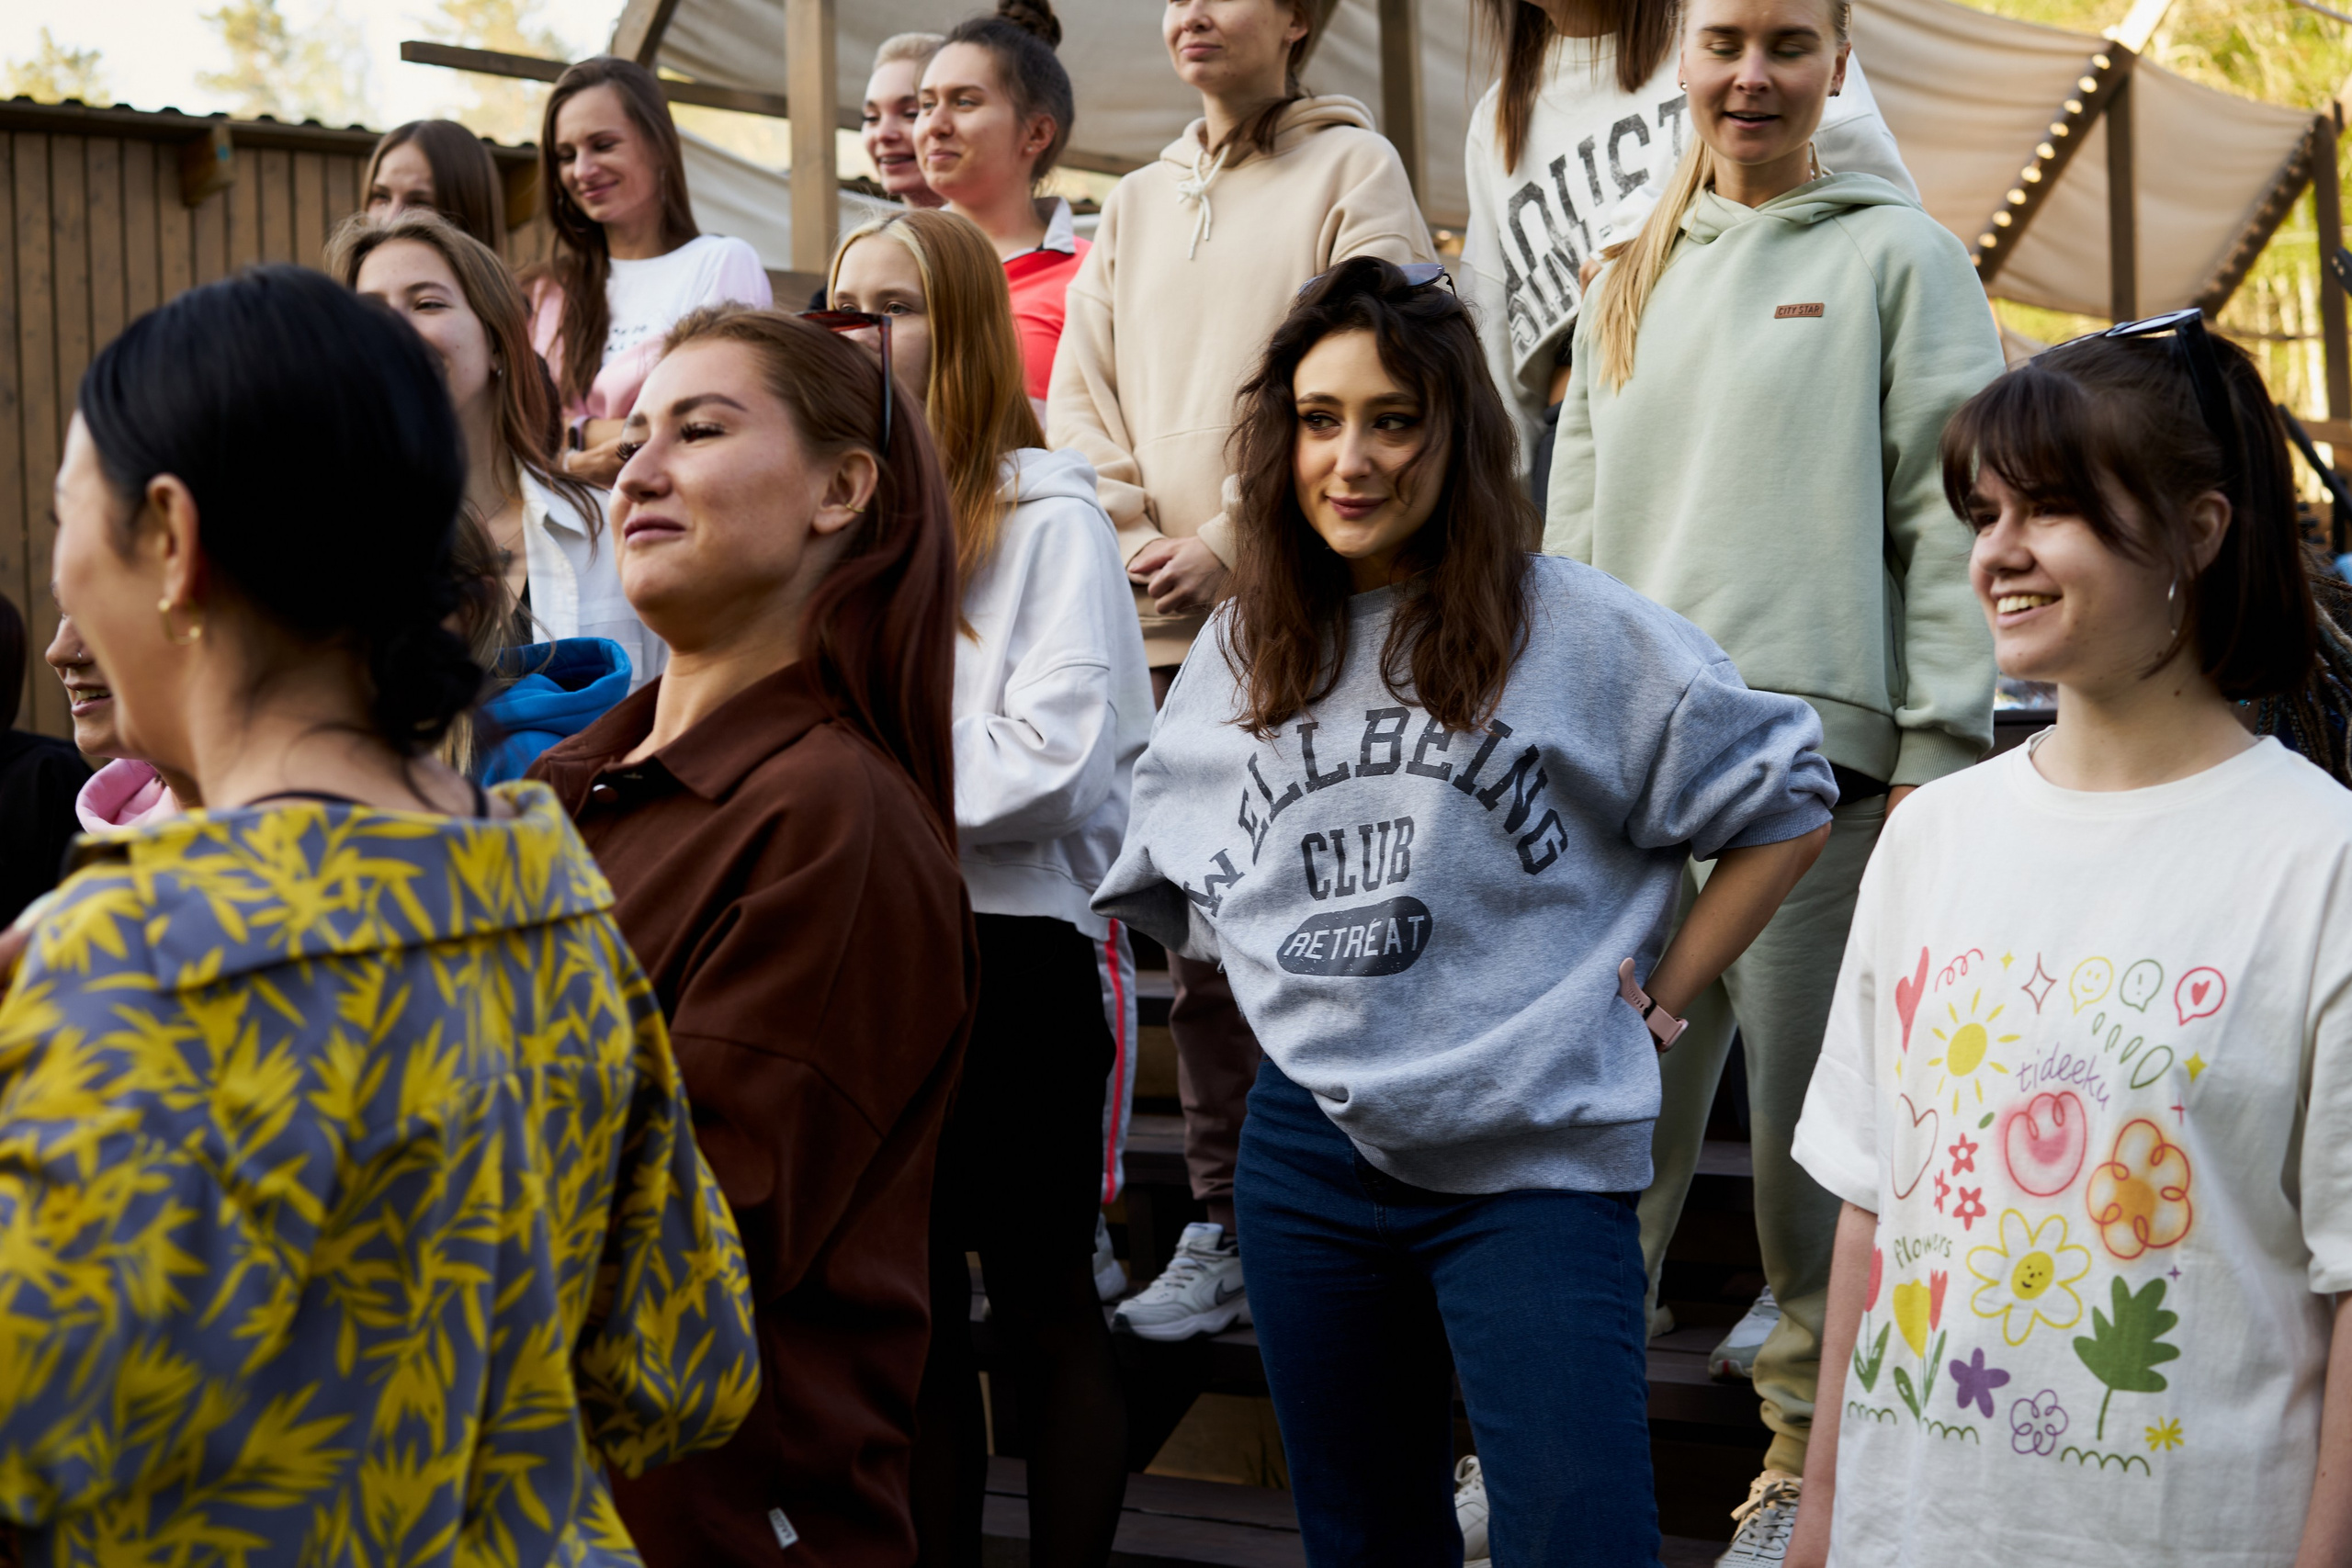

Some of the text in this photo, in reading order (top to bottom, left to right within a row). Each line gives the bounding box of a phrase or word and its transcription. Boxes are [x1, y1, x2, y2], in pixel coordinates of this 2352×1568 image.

[1778, 304, 1821, 316] CITY STAR
[1183, 706, 1568, 917] WELLBEING
[1301, 816, 1415, 901] CLUB
[1283, 915, 1426, 961] RETREAT
